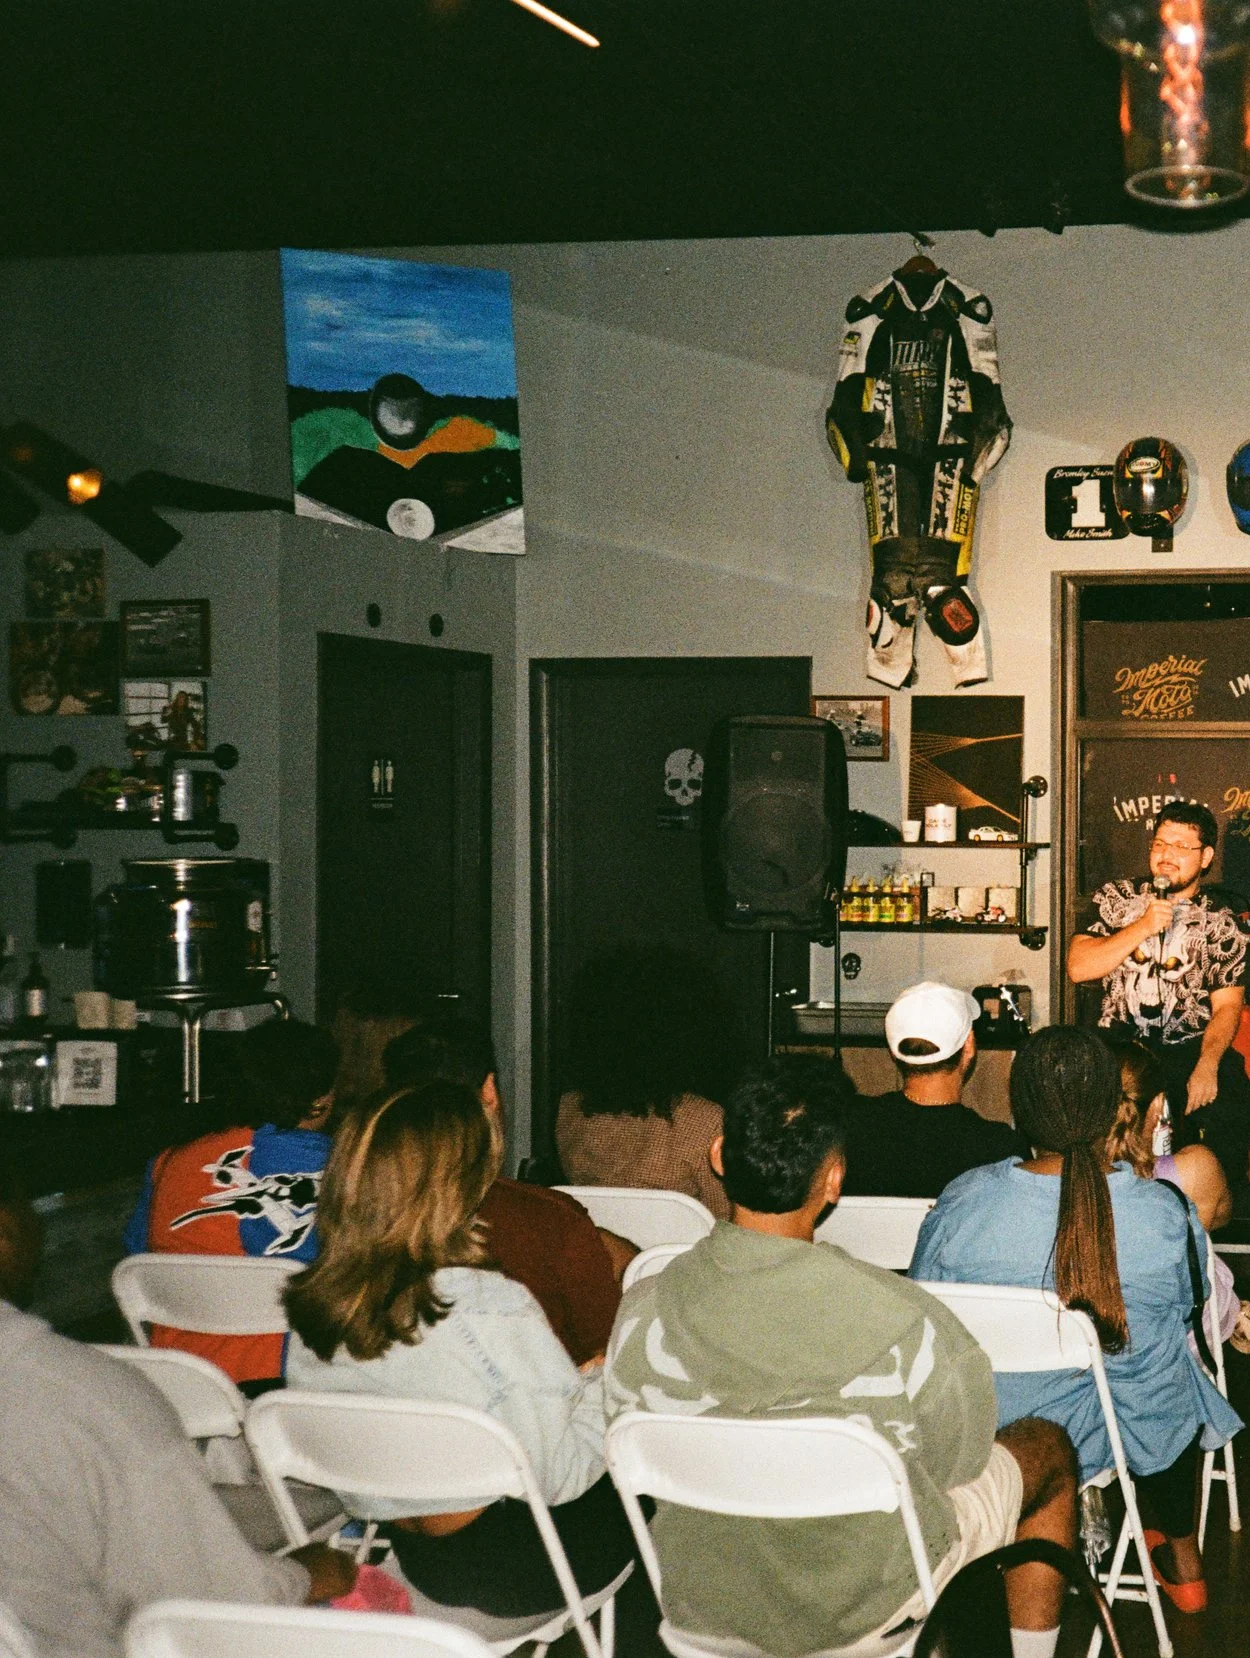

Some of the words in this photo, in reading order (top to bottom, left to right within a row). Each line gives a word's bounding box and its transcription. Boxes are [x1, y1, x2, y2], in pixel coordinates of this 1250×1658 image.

[1071, 479, 1105, 528] 1
[1112, 655, 1207, 693] Imperial
[1121, 681, 1192, 716] Moto
